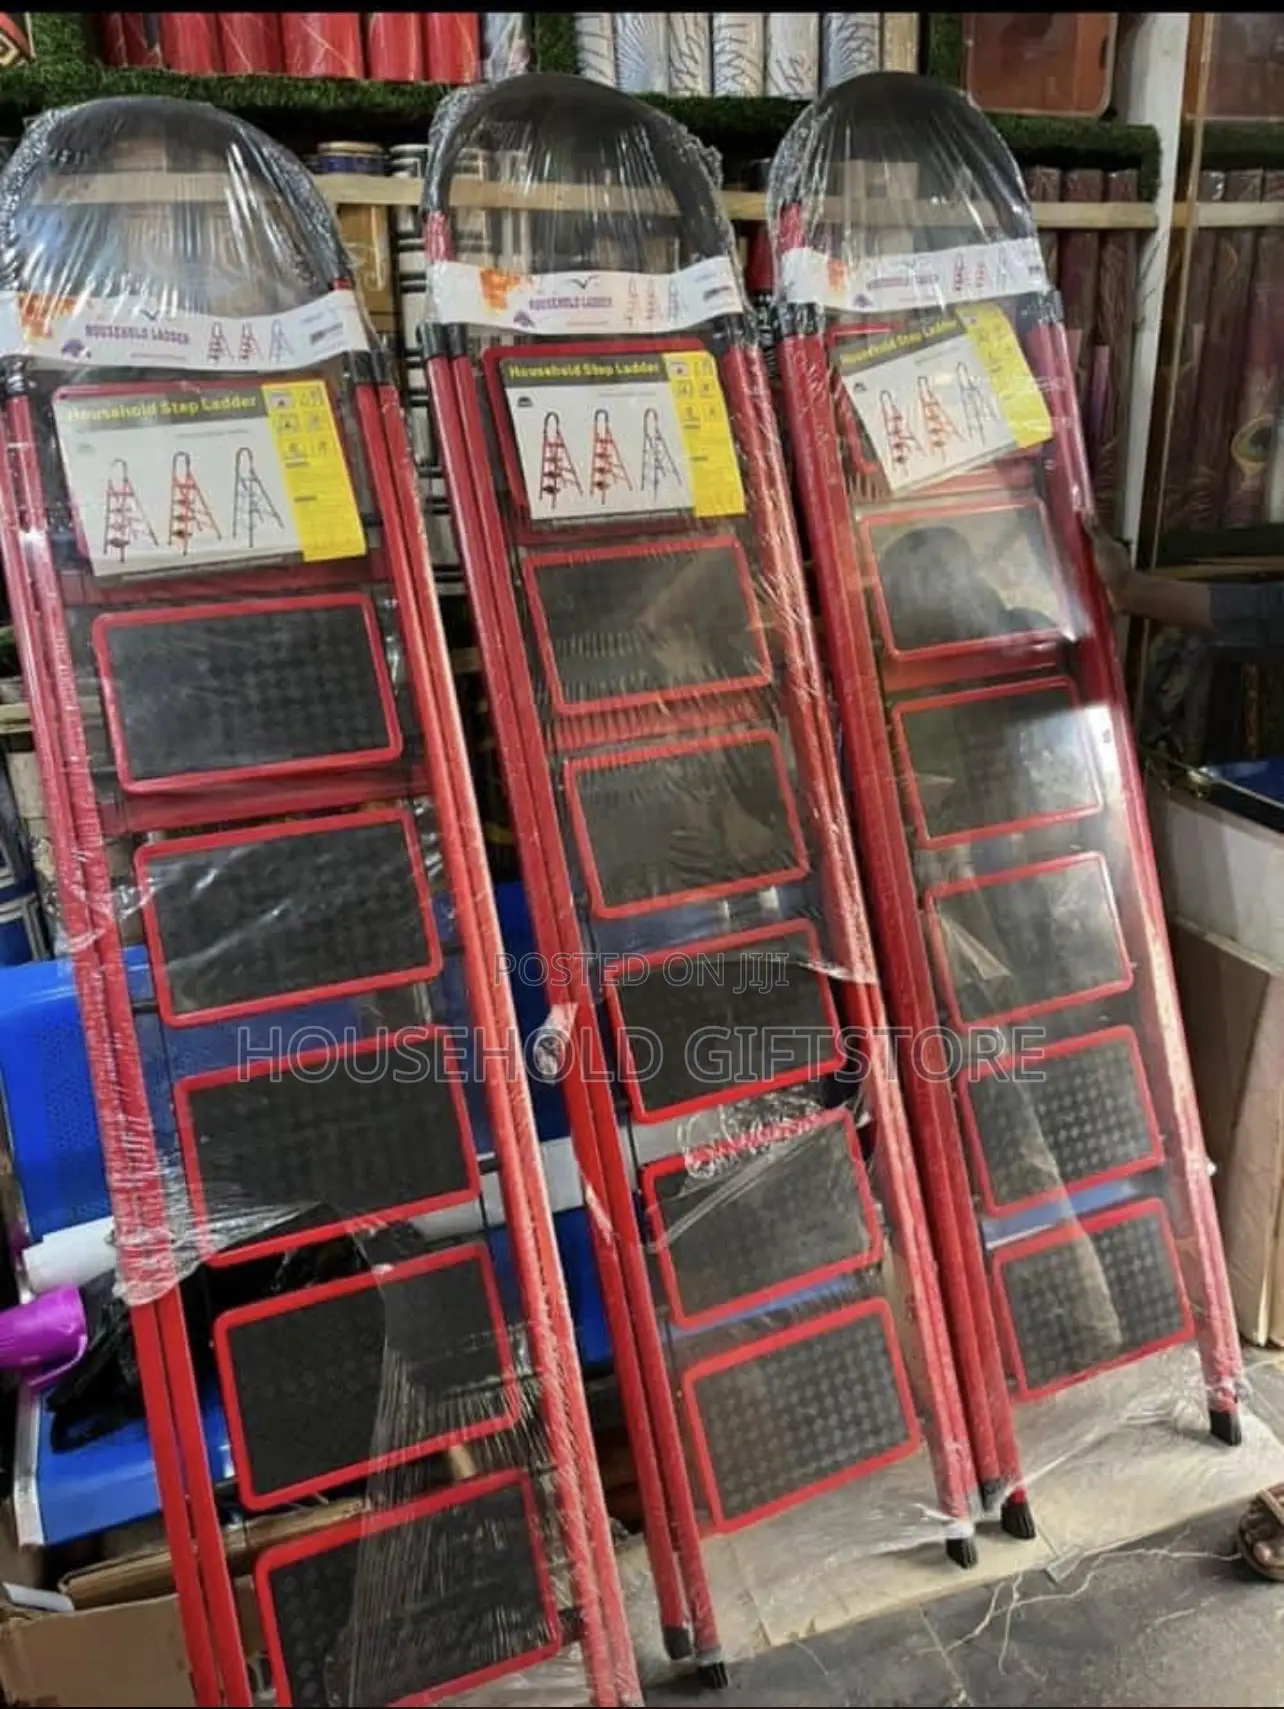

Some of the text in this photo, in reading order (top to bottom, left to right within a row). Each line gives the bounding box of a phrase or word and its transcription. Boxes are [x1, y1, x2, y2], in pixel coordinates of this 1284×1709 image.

[85, 324, 190, 344] HOUSEHOLD LADDER
[508, 361, 658, 378] Household Step Ladder
[67, 392, 257, 421] Household Step Ladder
